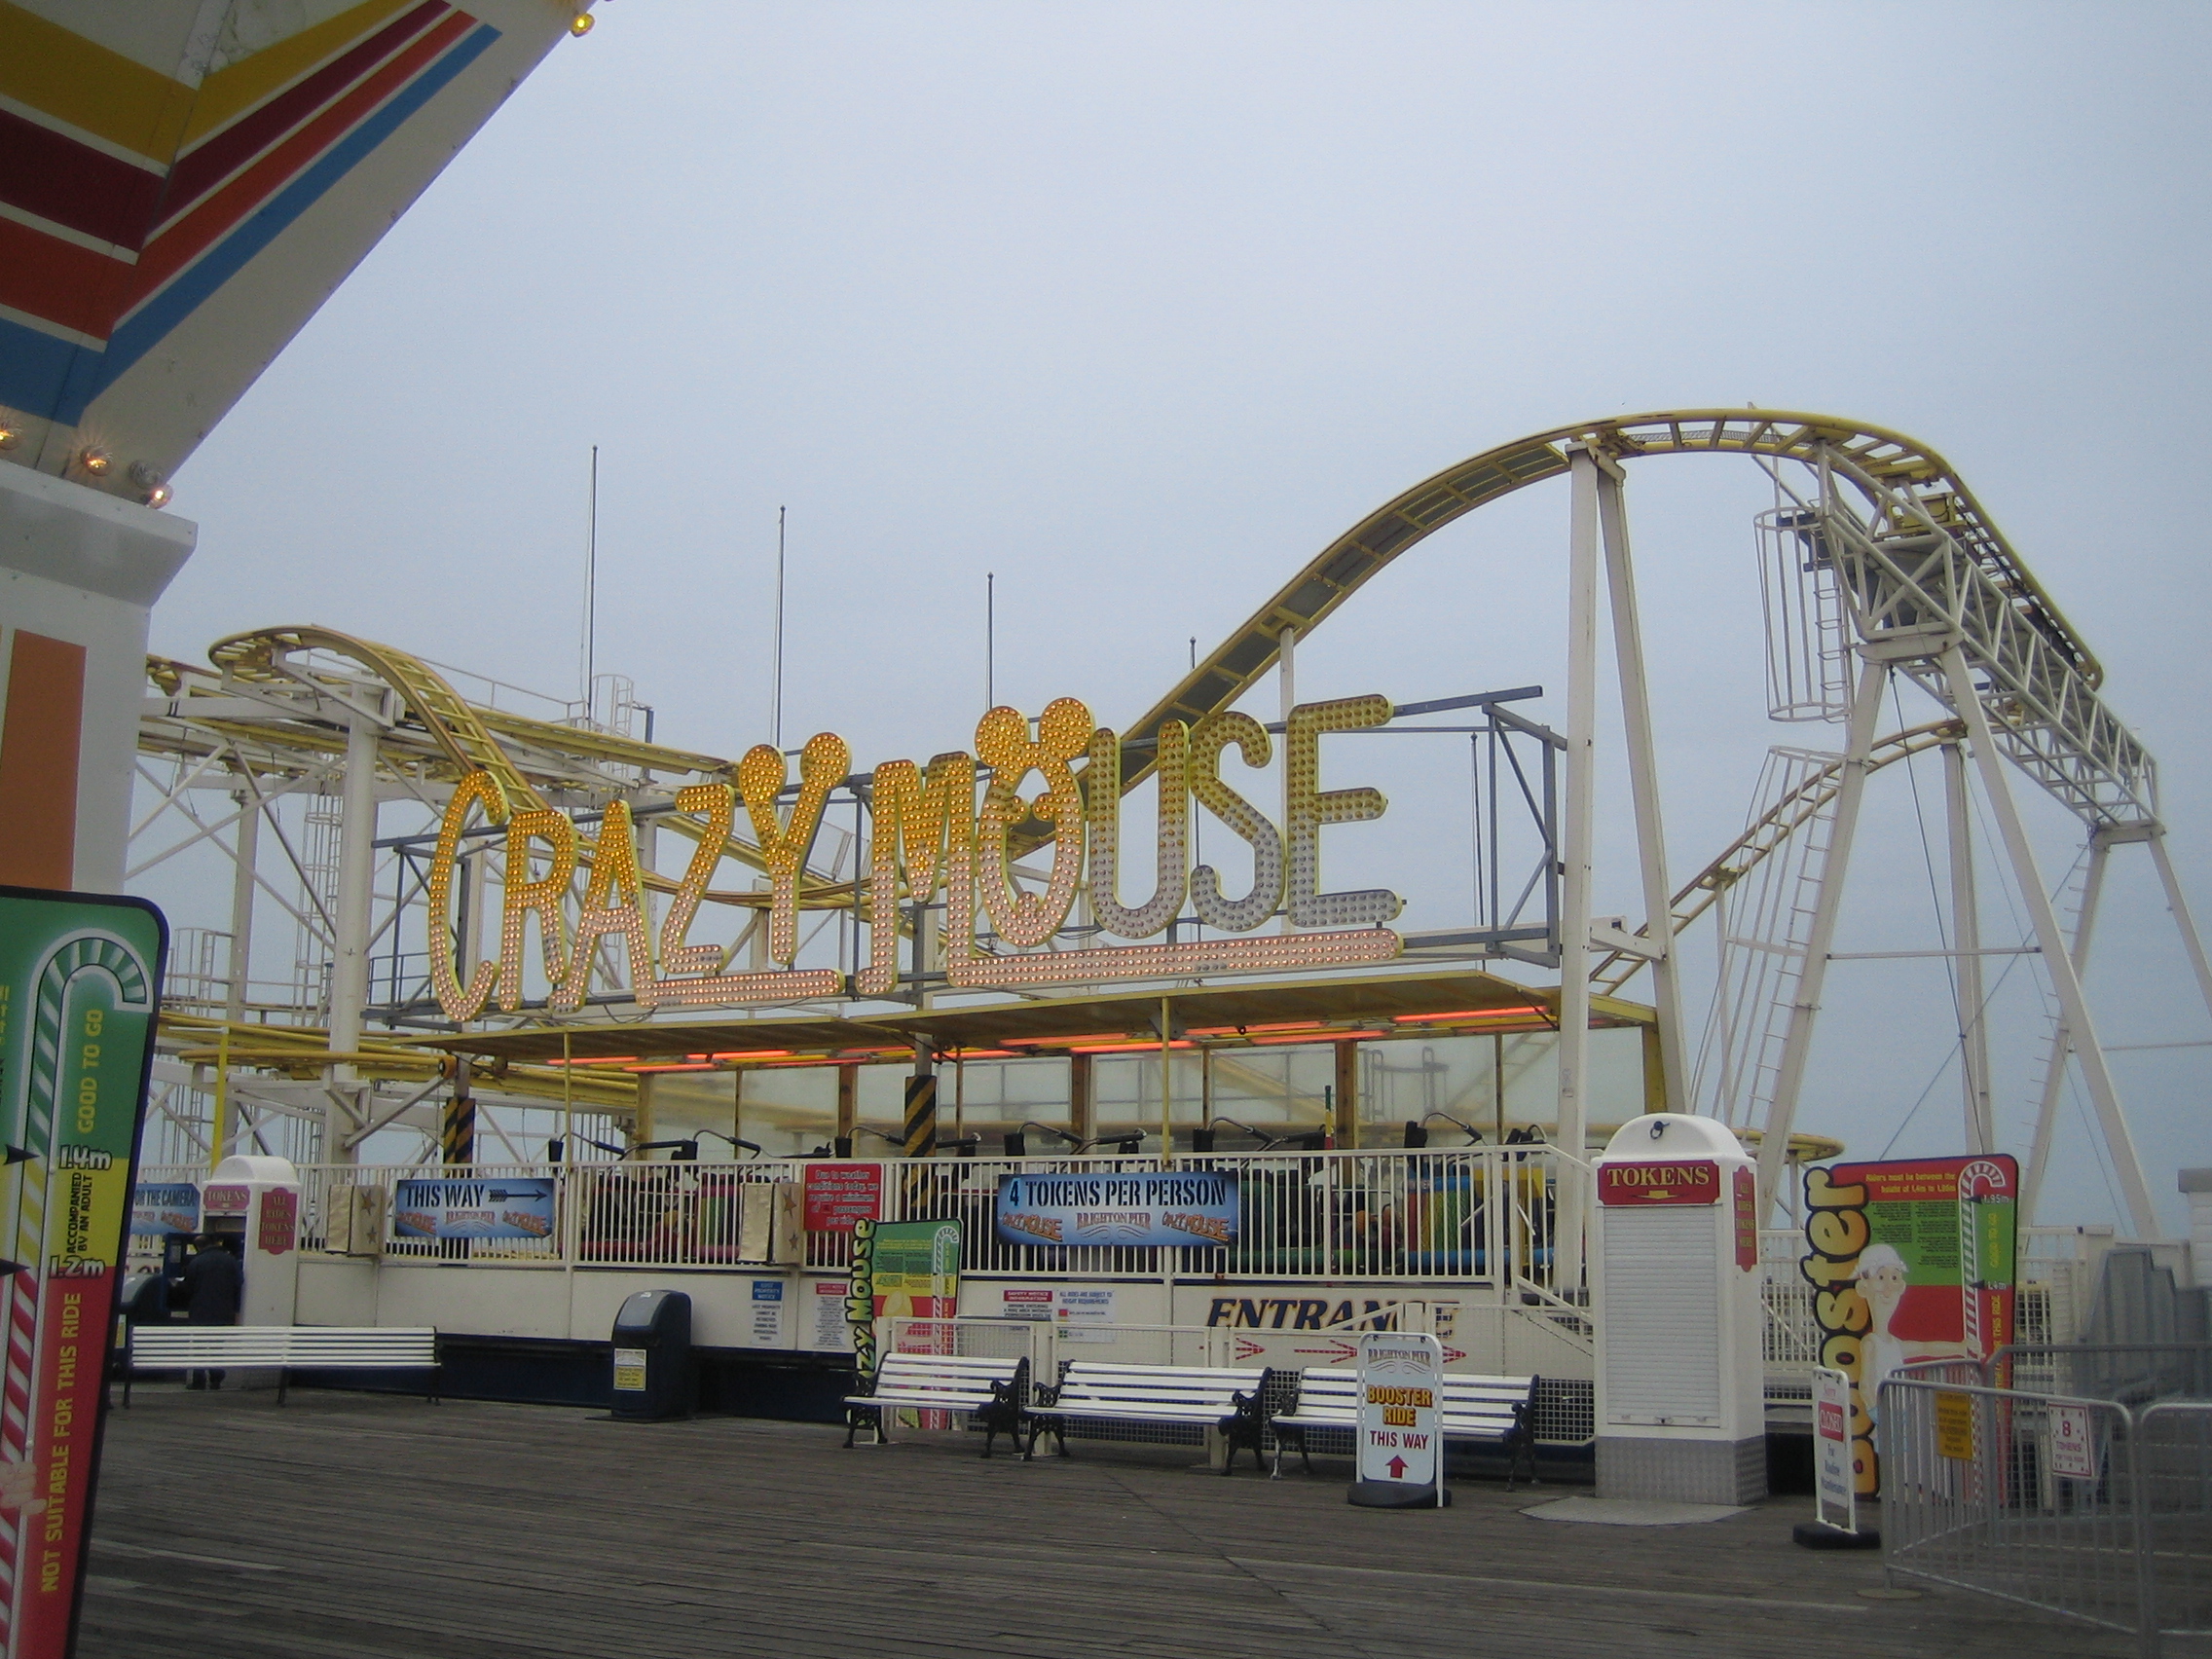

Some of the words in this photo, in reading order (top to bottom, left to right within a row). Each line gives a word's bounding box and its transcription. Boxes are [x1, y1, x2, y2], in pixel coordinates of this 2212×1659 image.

[429, 731, 851, 1021] CRAZY
[857, 693, 1404, 994] MOUSE
[85, 1009, 104, 1037] GO
[82, 1043, 101, 1070] TO
[77, 1077, 98, 1134] GOOD
[59, 1144, 112, 1171] 1.4m
[1606, 1166, 1711, 1187] TOKENS
[82, 1175, 93, 1209] ADULT
[207, 1188, 247, 1202] TOKENS
[406, 1184, 441, 1208] THIS
[445, 1184, 486, 1208] WAY
[1009, 1177, 1021, 1207] 4
[1025, 1179, 1101, 1207] TOKENS
[1105, 1179, 1142, 1207] PER
[1145, 1178, 1227, 1207] PERSON
[1983, 1194, 2009, 1205] 1.95m
[66, 1172, 83, 1254] ACCOMPANIED
[80, 1212, 91, 1231] AN
[1076, 1212, 1128, 1230] BRIGHTON
[1128, 1212, 1152, 1230] PIER
[261, 1222, 295, 1232] TOKENS
[77, 1235, 88, 1251] BY
[50, 1255, 105, 1279] 1.2m
[62, 1292, 83, 1339] RIDE
[1206, 1297, 1461, 1339] ENTRANE
[57, 1346, 78, 1390] THIS
[1367, 1348, 1410, 1365] BRIGHTON
[1411, 1349, 1431, 1365] PIER
[1367, 1384, 1433, 1408] BOOSTER
[54, 1397, 74, 1438] FOR
[1382, 1406, 1417, 1427] RIDE
[2062, 1419, 2072, 1437] 8
[1369, 1430, 1398, 1448] THIS
[1403, 1433, 1429, 1450] WAY
[45, 1445, 70, 1545] SUITABLE
[41, 1552, 62, 1593] NOT
